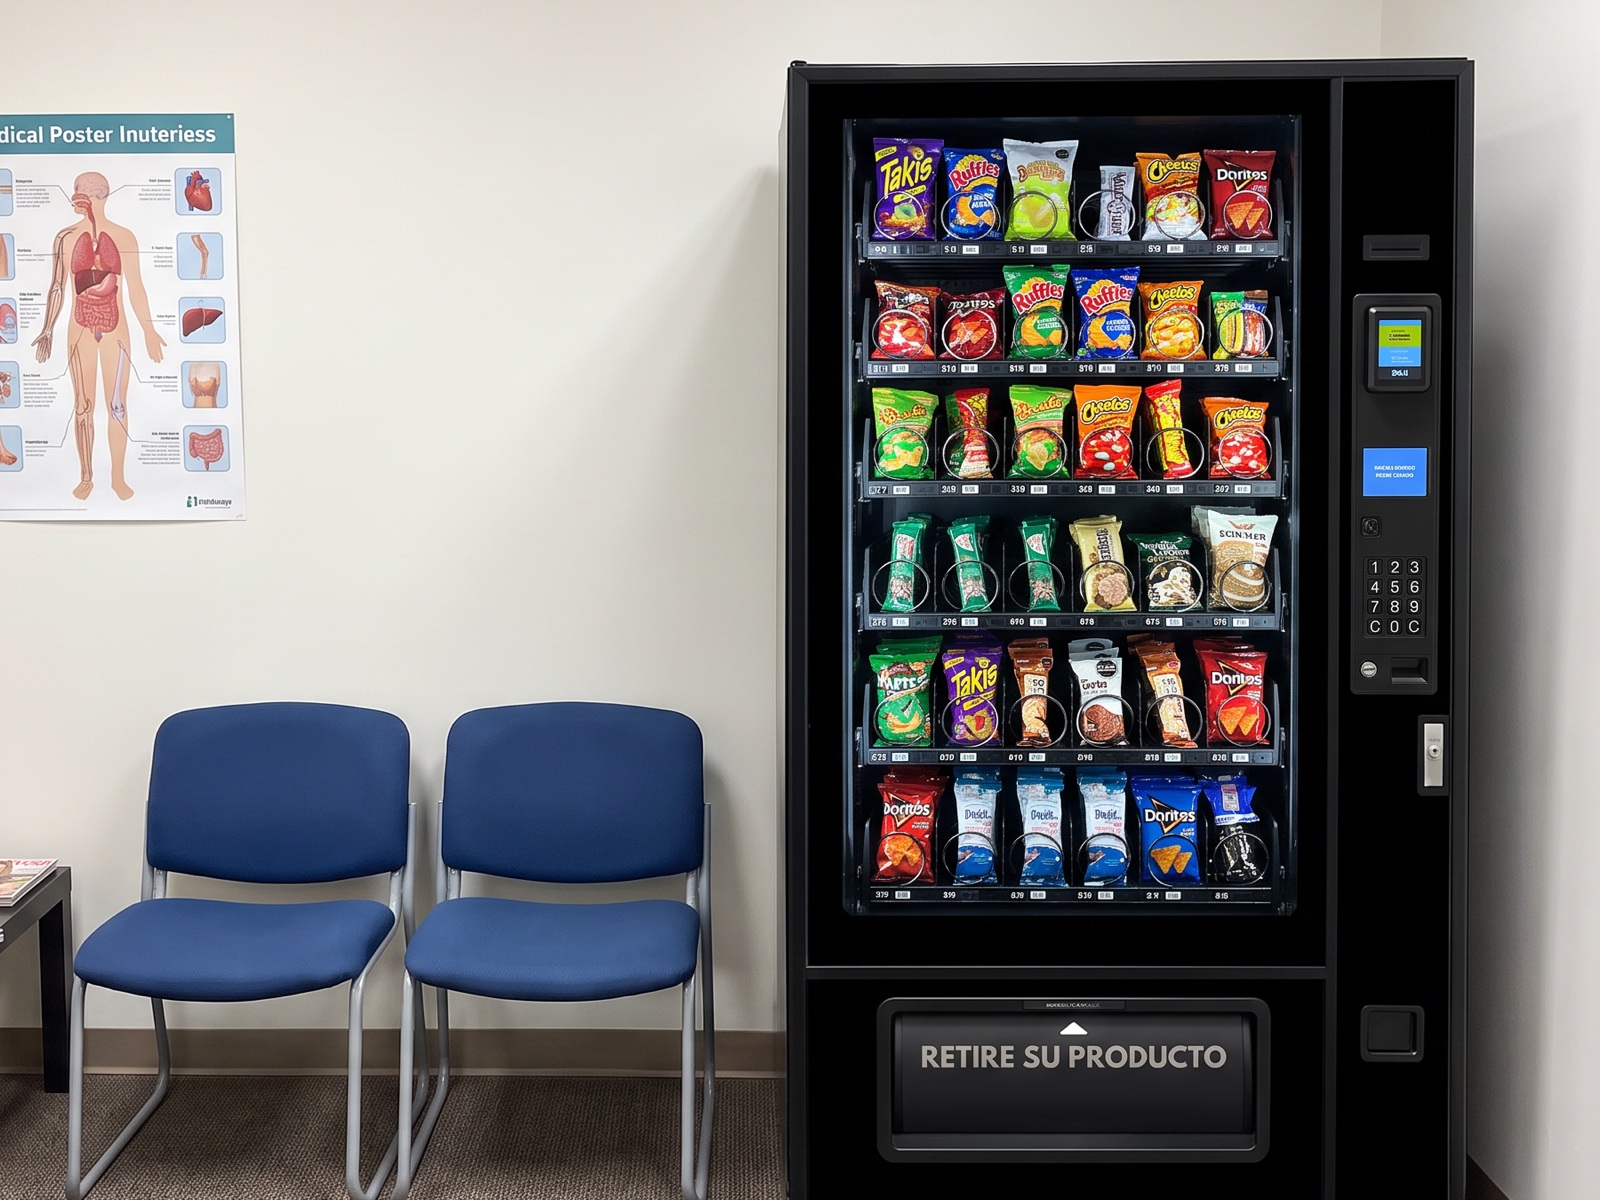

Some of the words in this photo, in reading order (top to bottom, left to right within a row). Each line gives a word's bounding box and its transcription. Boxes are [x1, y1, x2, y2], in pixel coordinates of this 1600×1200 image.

[50, 125, 114, 144] Poster
[119, 124, 217, 143] Inuteriess
[880, 155, 933, 198] Takis
[948, 160, 1000, 191] Ruffles
[1216, 168, 1268, 182] Doritos
[1011, 280, 1065, 315] Ruffles
[1080, 283, 1133, 316] Ruffles
[1148, 284, 1197, 311] Cheetos
[1214, 405, 1263, 429] Cheetos
[1371, 561, 1378, 574] 1
[1390, 561, 1400, 574] 2
[1410, 561, 1420, 574] 3
[1370, 581, 1380, 594] 4
[1390, 581, 1400, 594] 5
[1410, 581, 1420, 594] 6
[1371, 600, 1380, 613] 7
[1390, 600, 1400, 613] 8
[1410, 600, 1419, 613] 9
[1370, 620, 1381, 633] C
[1409, 620, 1420, 633] C
[951, 662, 999, 705] Takis
[1211, 671, 1263, 685] Doritos
[1144, 808, 1196, 823] Doritos
[921, 1045, 1015, 1069] RETIRE
[1022, 1045, 1061, 1069] SU
[1069, 1045, 1227, 1069] PRODUCTO
